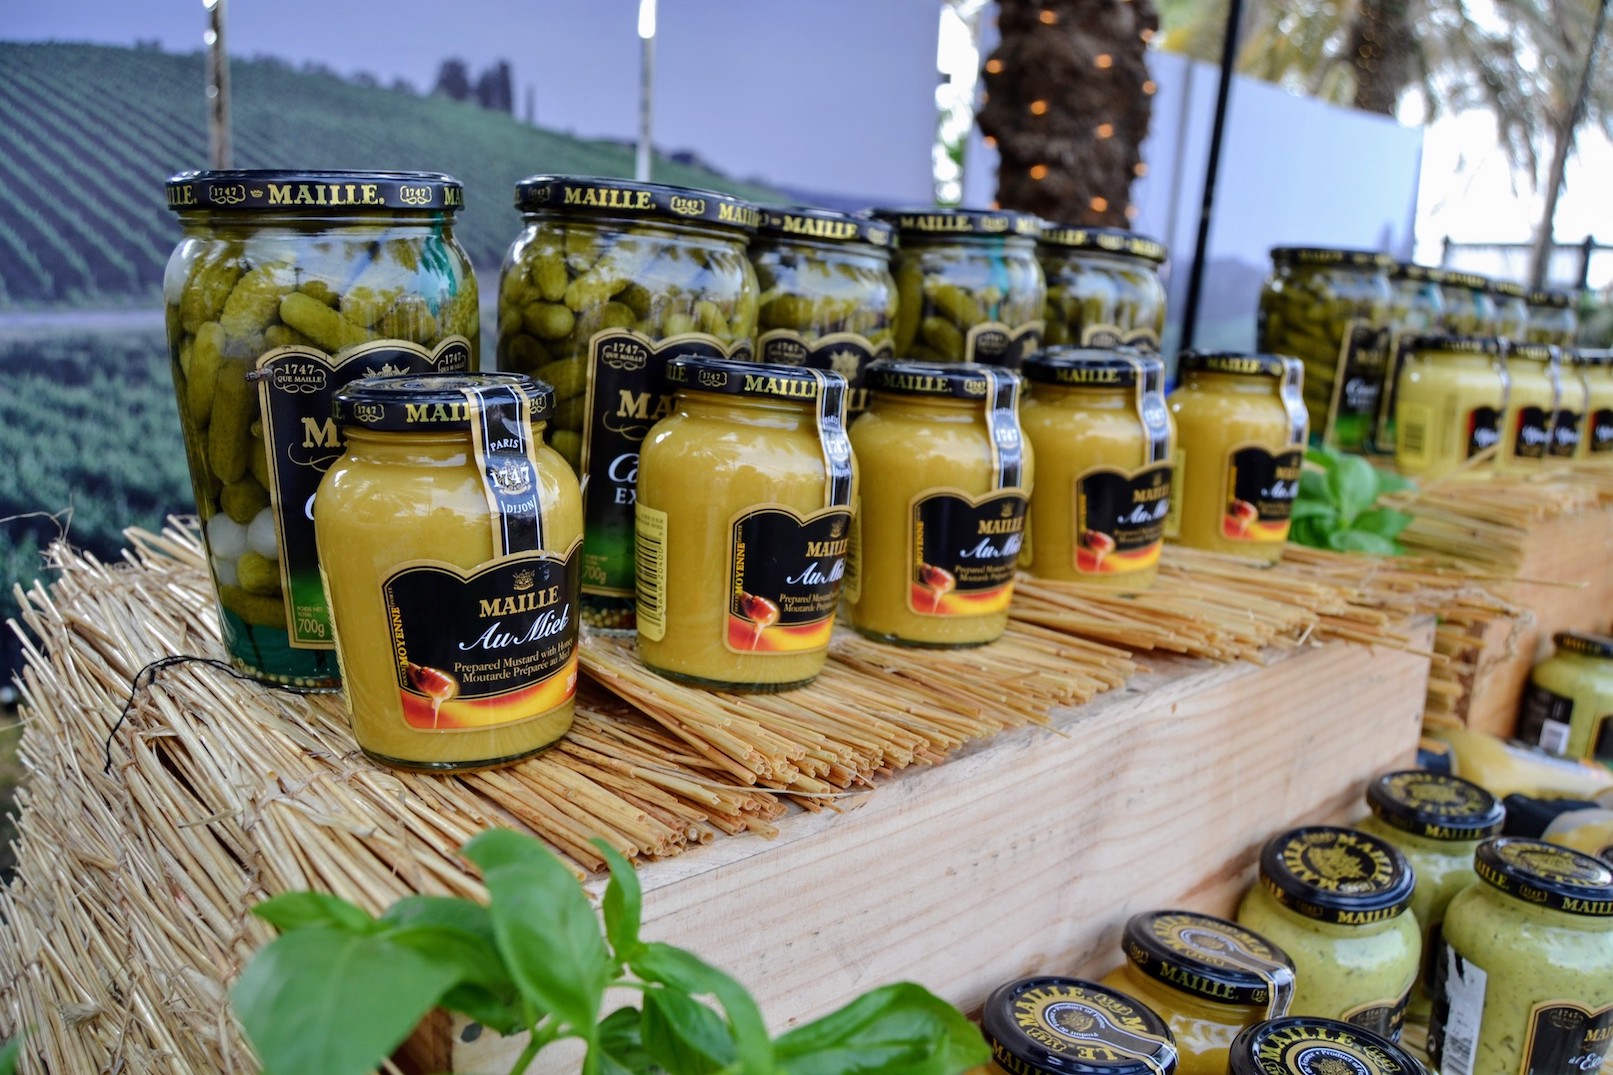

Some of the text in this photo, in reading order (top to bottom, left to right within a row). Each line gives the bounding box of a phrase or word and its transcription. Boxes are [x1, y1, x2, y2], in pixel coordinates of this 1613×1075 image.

[214, 187, 237, 196] 1747
[406, 188, 426, 197] 1747
[676, 199, 698, 208] 1747
[613, 342, 638, 354] 1747
[445, 351, 461, 365] 1747
[284, 363, 314, 375] 1747
[702, 372, 721, 380] 1747
[357, 406, 377, 415] 1747
[490, 438, 519, 452] PARIS
[490, 466, 530, 487] 1747
[506, 499, 534, 513] DIJON
[583, 565, 607, 585] 700g
[735, 542, 746, 596] MOYENNE
[786, 561, 822, 585] Au
[479, 585, 560, 618] MAILLE
[298, 618, 325, 637] 700g
[459, 603, 570, 651] Au Miel
[391, 607, 410, 668] MOYENNE
[454, 639, 574, 675] Prepared Mustard with Honey
[463, 648, 572, 683] Moutarde Préparée au Miel
[1337, 906, 1400, 924] MAILLE
[1321, 1050, 1353, 1063] Product
